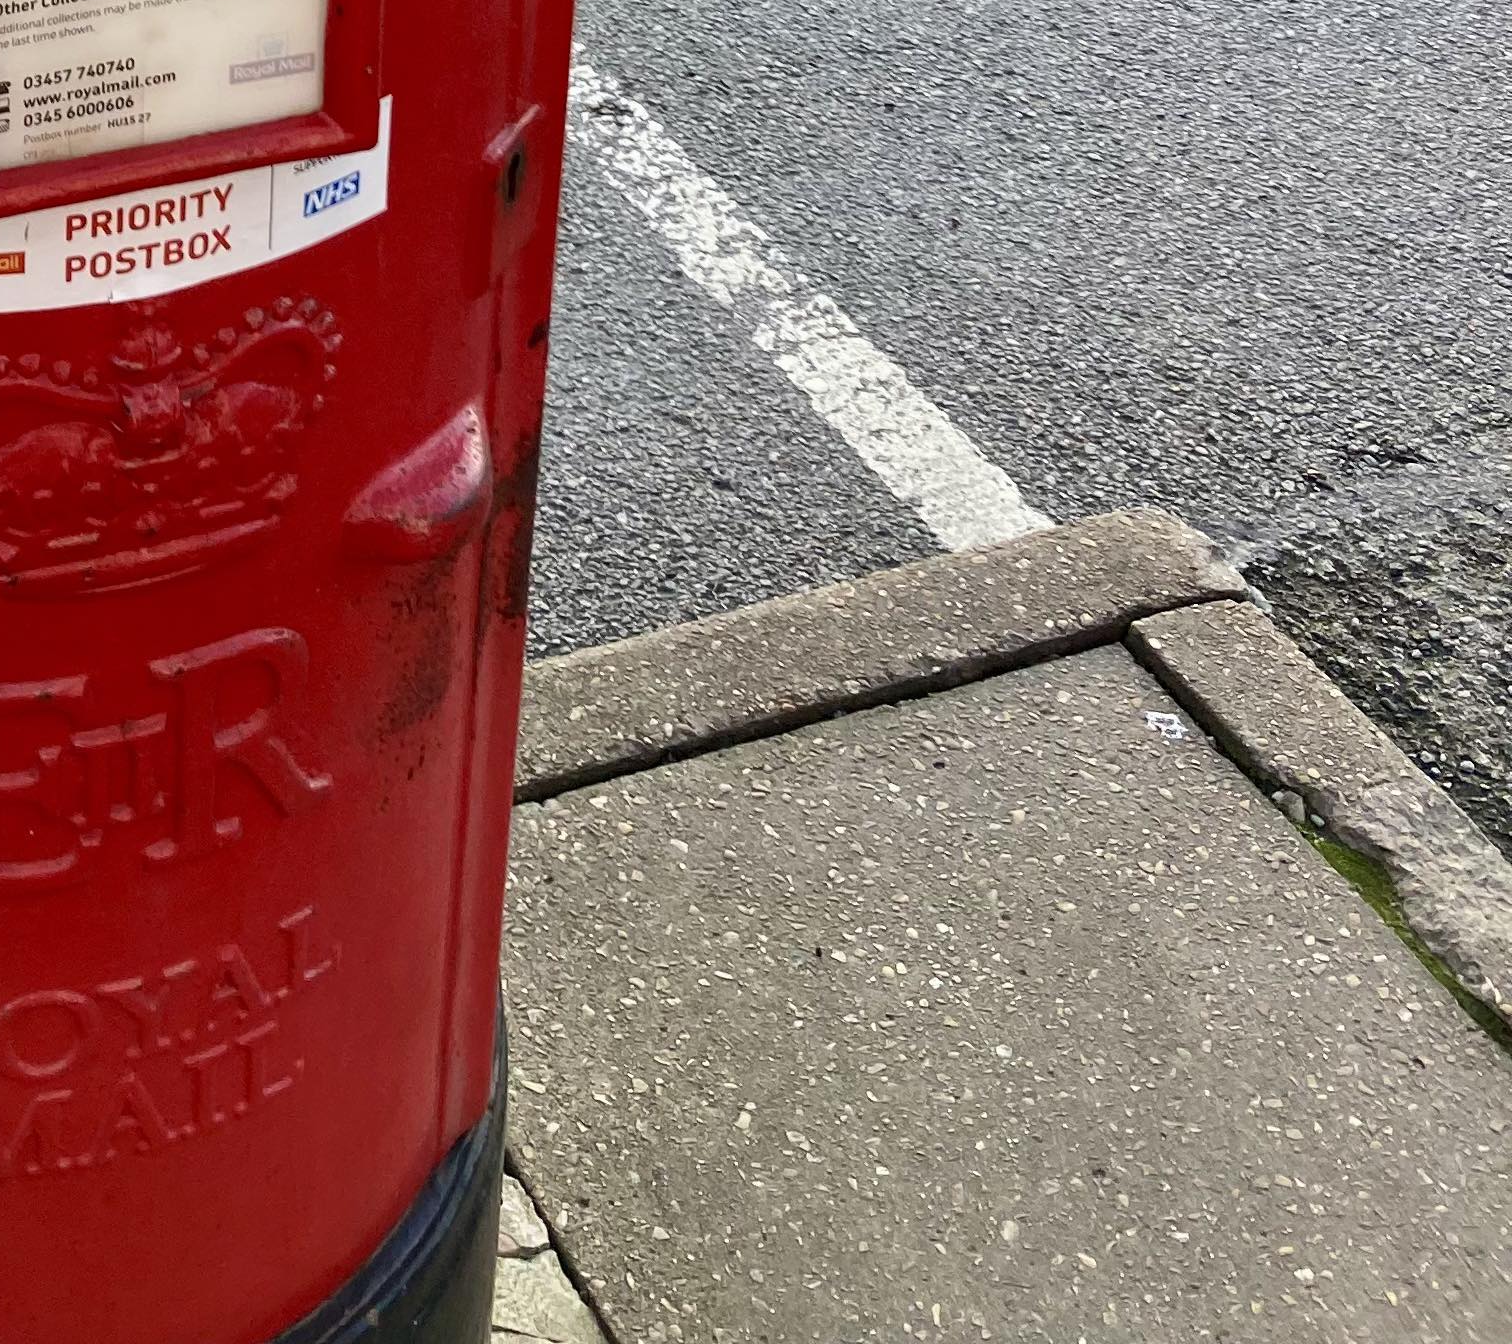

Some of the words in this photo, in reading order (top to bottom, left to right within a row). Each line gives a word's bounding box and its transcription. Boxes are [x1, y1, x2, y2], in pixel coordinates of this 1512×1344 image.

[46, 7, 102, 27] collections
[104, 3, 127, 17] may
[11, 34, 31, 48] last
[32, 31, 57, 44] time
[58, 23, 96, 39] shown.
[23, 68, 73, 91] 03457
[76, 57, 136, 82] 740740
[234, 60, 276, 81] Royal
[278, 54, 313, 75] Mail
[23, 69, 177, 109] www.royalmail.com
[23, 109, 63, 128] 0345
[66, 94, 135, 120] 6000606
[305, 172, 359, 215] NHS
[64, 182, 234, 242] PRIORITY
[64, 223, 232, 284] POSTBOX
